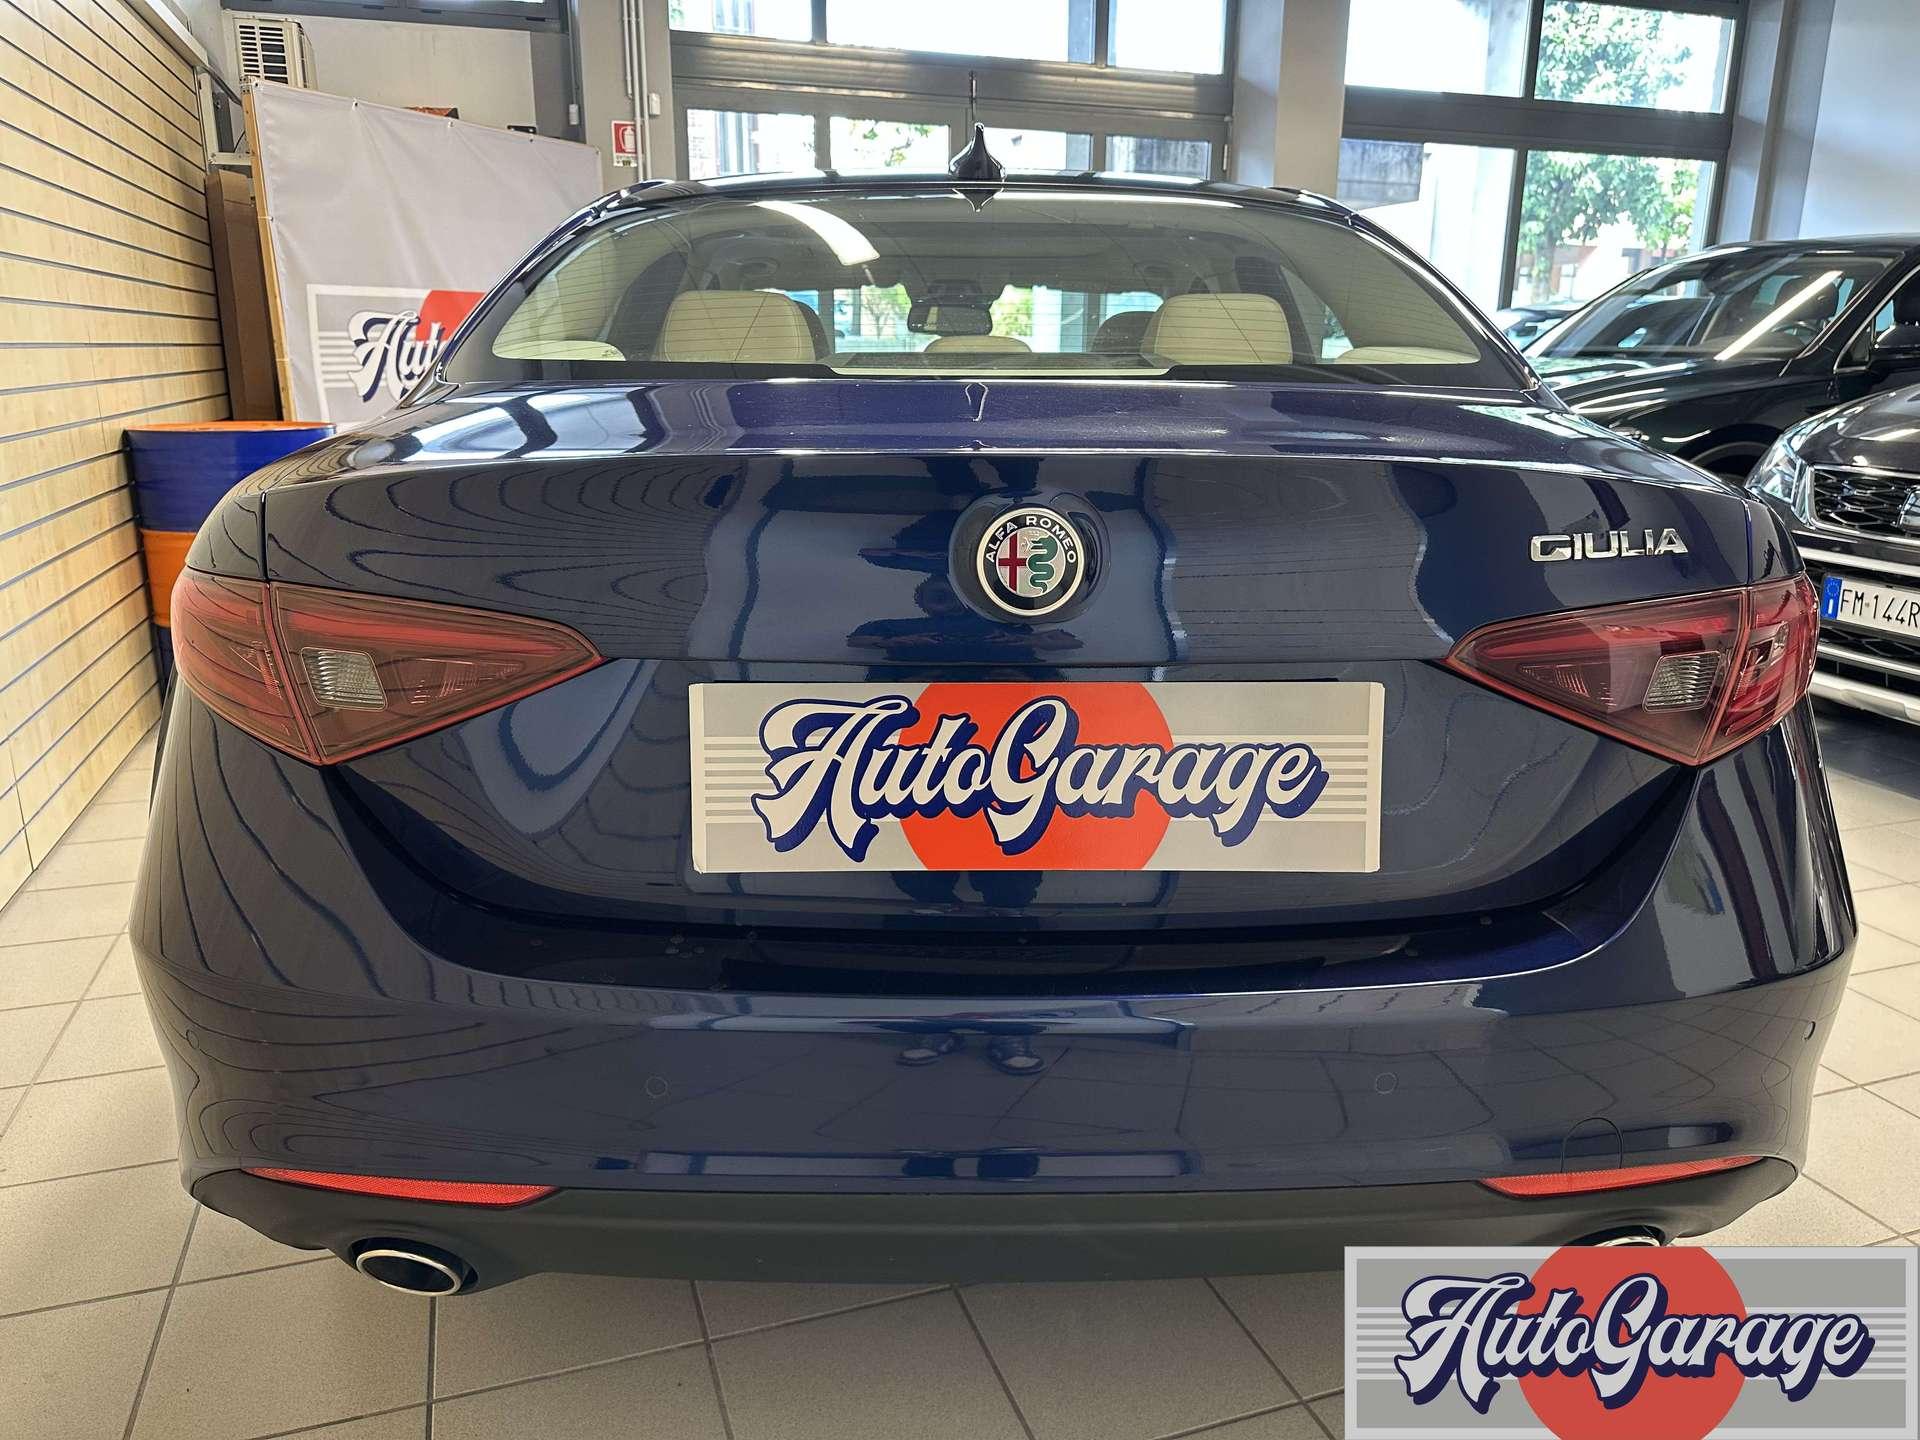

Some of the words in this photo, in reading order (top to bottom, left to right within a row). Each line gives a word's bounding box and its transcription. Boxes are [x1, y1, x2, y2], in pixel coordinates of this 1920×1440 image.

[986, 521, 1018, 563] ALFA
[1025, 515, 1077, 564] ROMEO
[1531, 528, 1689, 562] GIULIA
